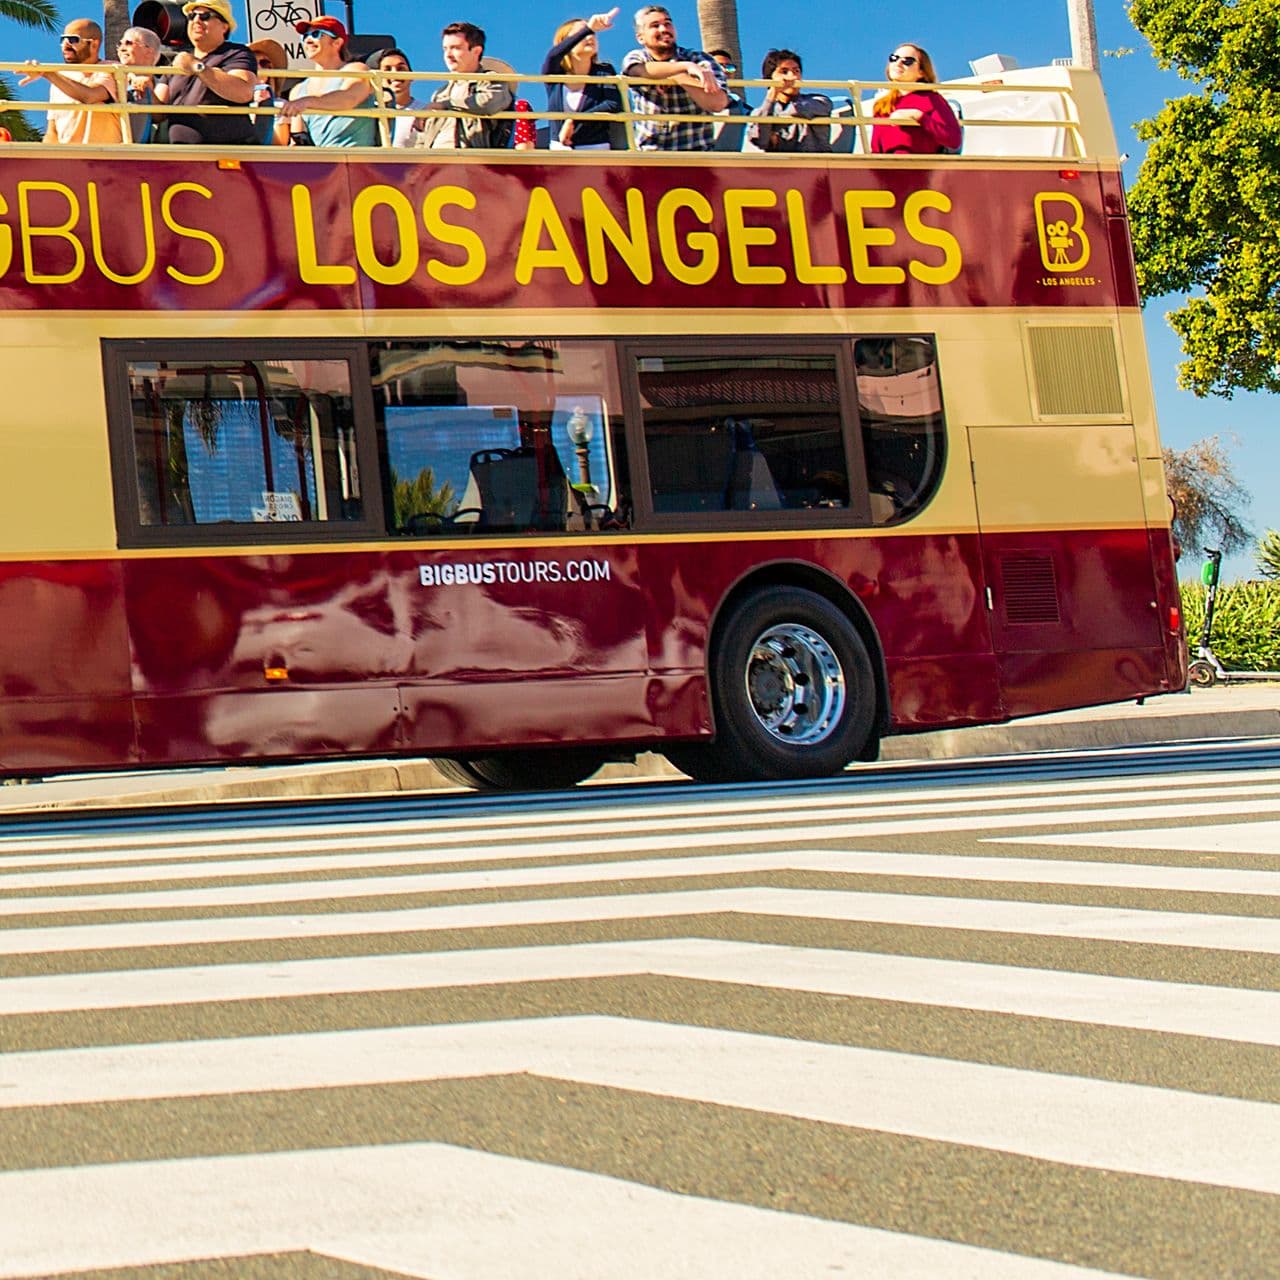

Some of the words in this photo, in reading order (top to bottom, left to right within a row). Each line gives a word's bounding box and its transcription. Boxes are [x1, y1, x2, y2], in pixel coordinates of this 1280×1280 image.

[291, 184, 488, 287] LOS
[515, 186, 963, 287] ANGELES
[1042, 277, 1058, 287] LOS
[1059, 276, 1095, 287] ANGELES
[419, 559, 611, 587] BIGBUSTOURS.COM
